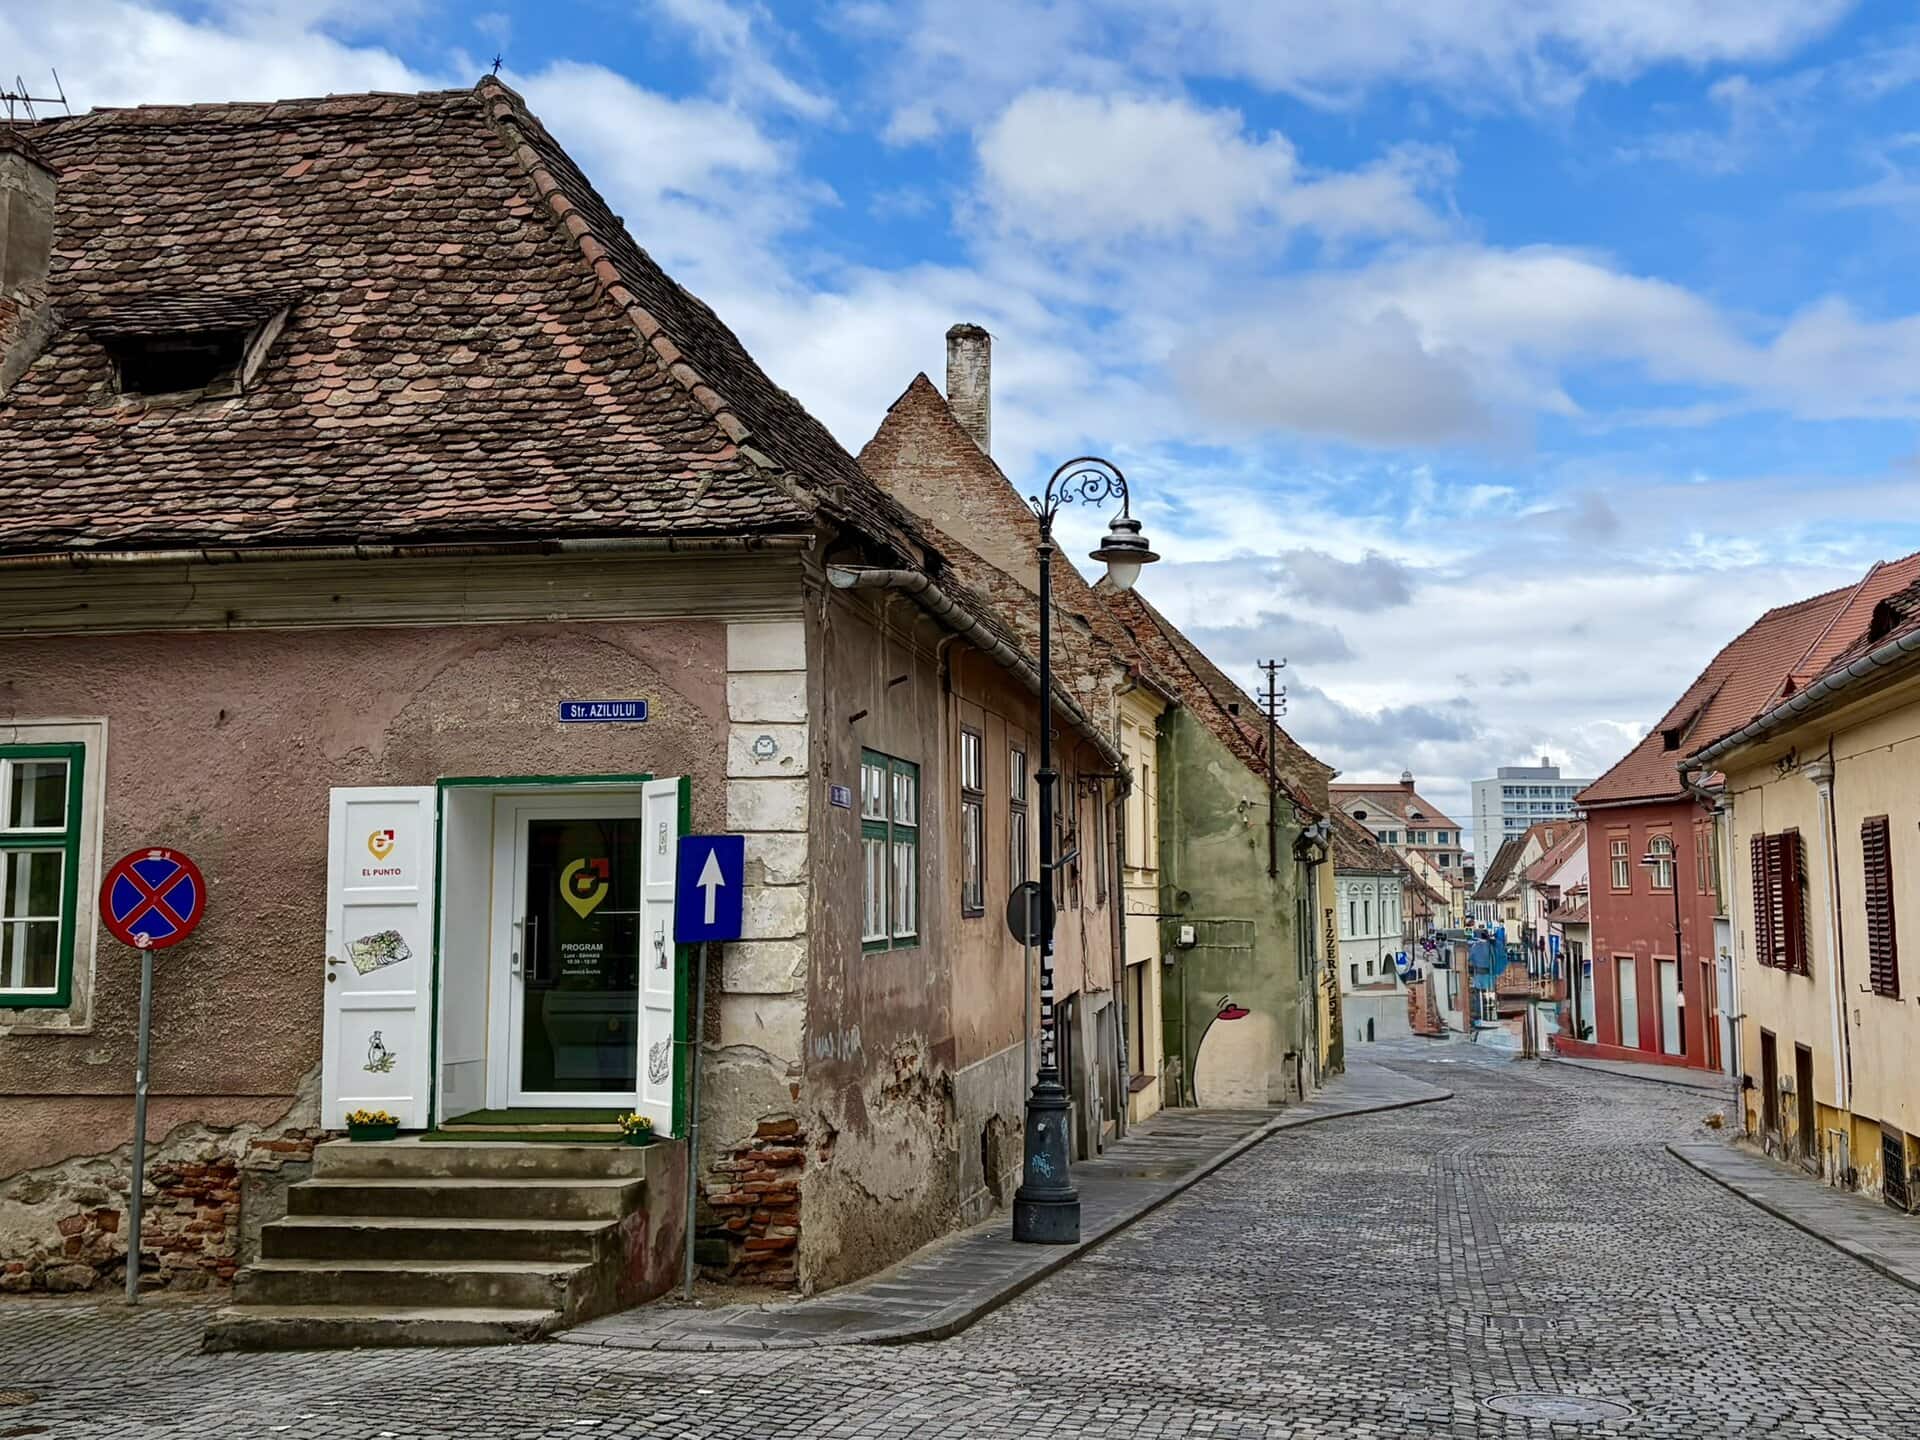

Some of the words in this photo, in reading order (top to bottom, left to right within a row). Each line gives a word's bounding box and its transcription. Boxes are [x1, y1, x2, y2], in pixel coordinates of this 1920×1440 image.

[570, 704, 588, 718] Str.
[589, 703, 636, 717] AZILULUI
[362, 868, 370, 876] EL
[373, 868, 401, 876] PUNTO
[561, 943, 604, 951] PROGRAM
